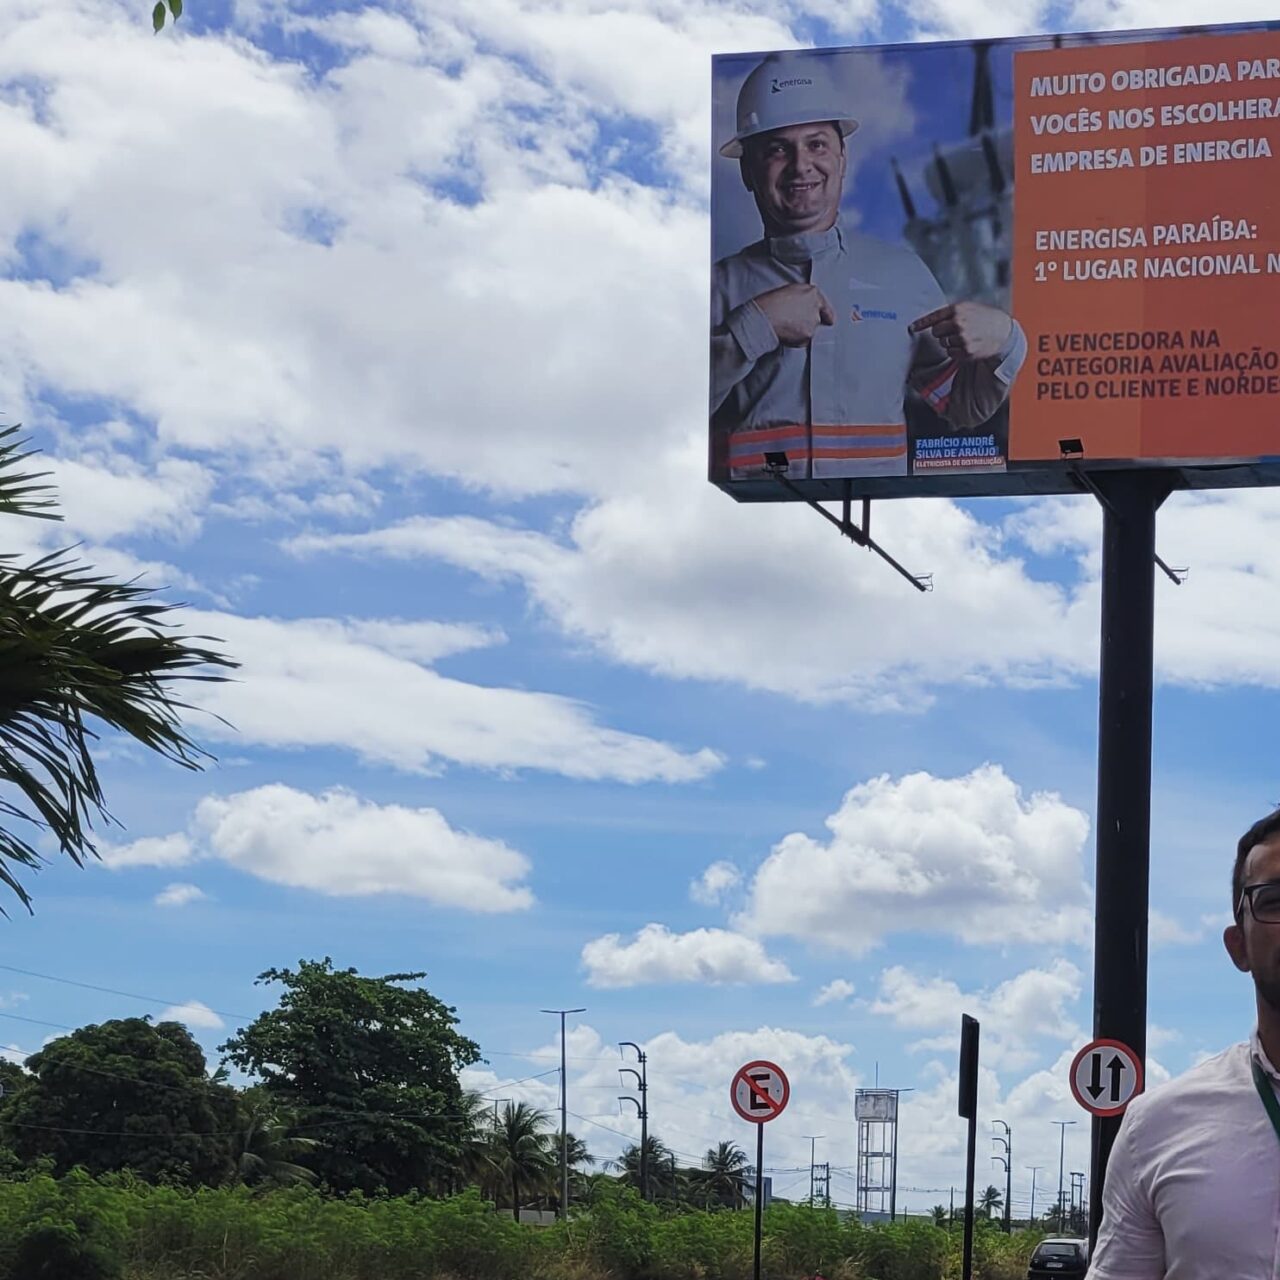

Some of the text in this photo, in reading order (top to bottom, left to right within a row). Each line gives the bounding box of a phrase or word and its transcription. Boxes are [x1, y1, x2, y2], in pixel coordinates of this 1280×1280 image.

[1030, 72, 1105, 97] MUITO
[1111, 62, 1232, 92] OBRIGADA
[1030, 106, 1102, 135] VOCÊS
[1108, 108, 1155, 131] NOS
[1031, 148, 1134, 174] EMPRESA
[1140, 145, 1168, 166] DE
[1174, 136, 1272, 163] ENERGIA
[1036, 215, 1258, 251] ENERGISA PARAÍBA:
[1063, 258, 1138, 281] LUGAR
[1144, 253, 1260, 279] NACIONAL
[1038, 330, 1220, 352] E VENCEDORA NA
[1037, 347, 1278, 377] CATEGORIA AVALIAÇÃO
[1037, 380, 1090, 400] PELO
[1095, 377, 1180, 398] CLIENTE
[1187, 377, 1199, 397] E
[916, 434, 994, 448] FABRÍCIO ANDRÉ
[916, 449, 942, 459] SILVA
[944, 448, 957, 457] DE
